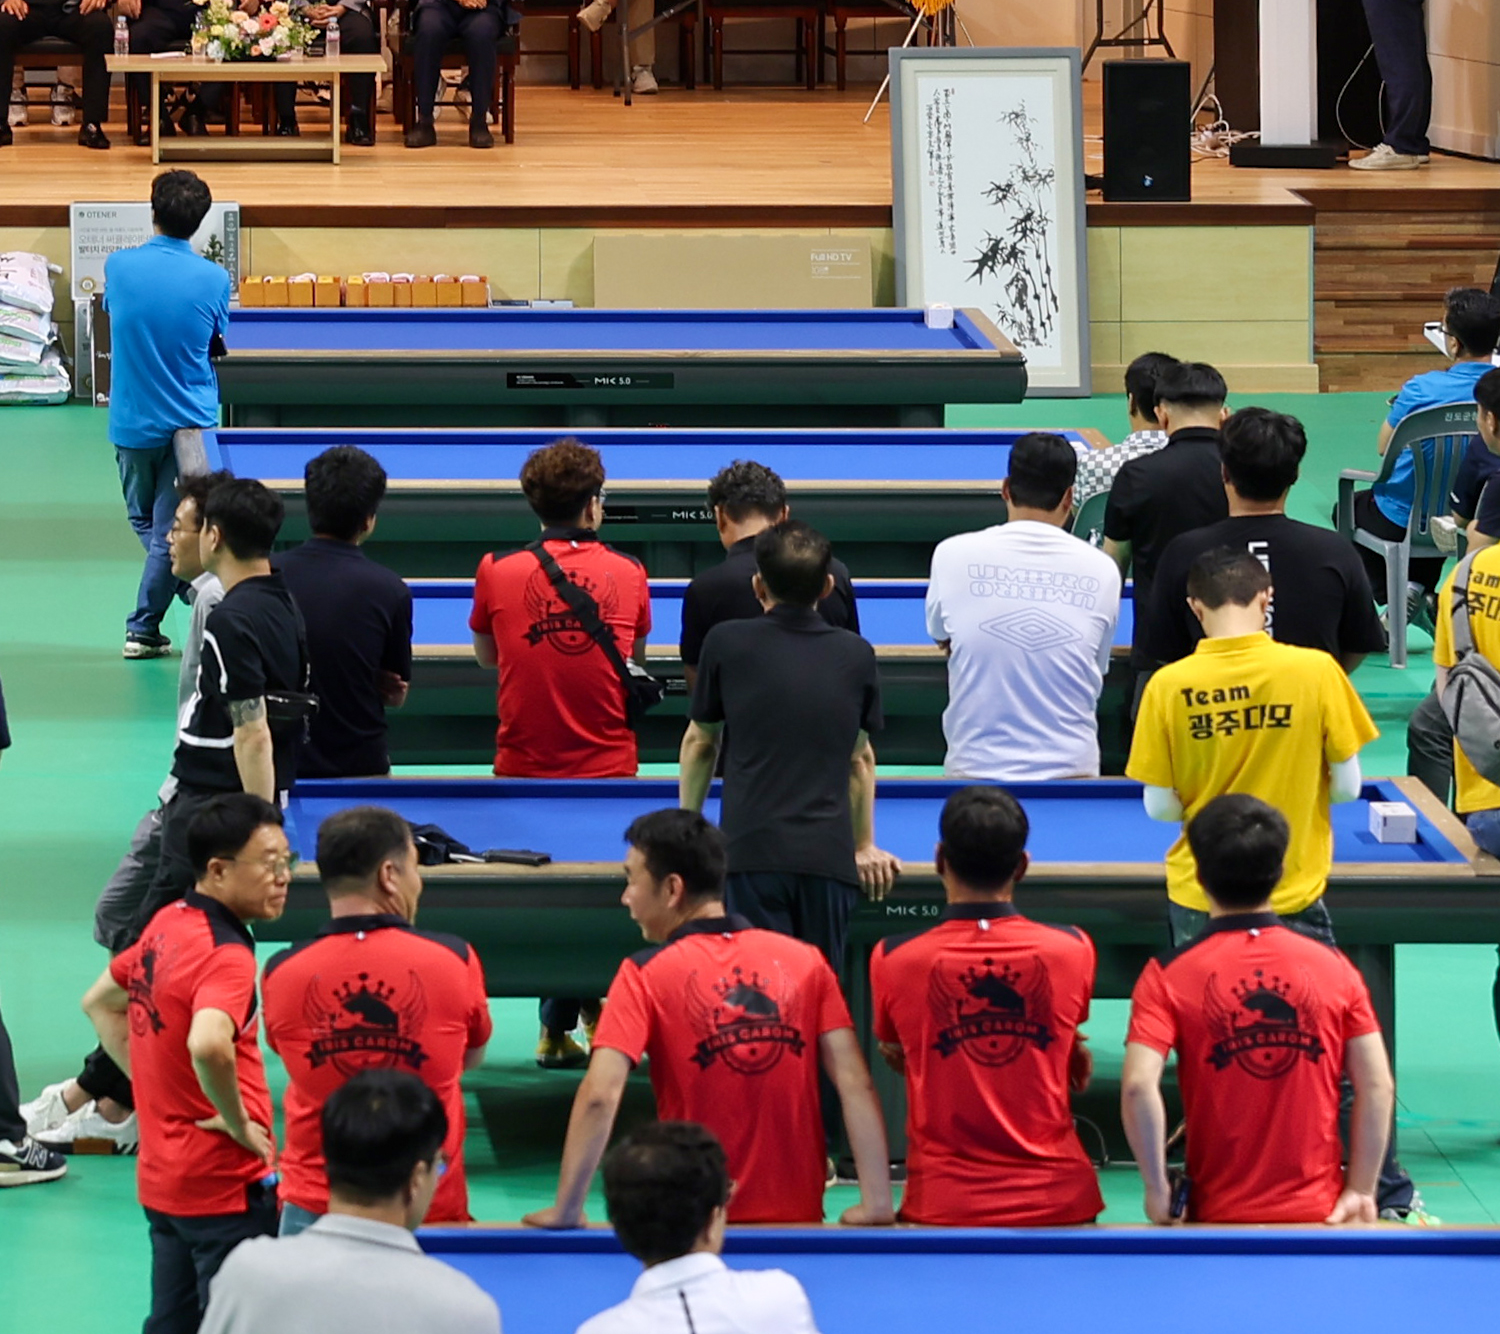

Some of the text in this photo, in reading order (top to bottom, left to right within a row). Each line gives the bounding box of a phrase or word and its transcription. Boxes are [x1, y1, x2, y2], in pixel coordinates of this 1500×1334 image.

[811, 253, 852, 261] Full HD TV
[618, 377, 631, 385] 5.0
[699, 511, 713, 520] 5.0
[967, 563, 1100, 595] UMBRO
[1181, 685, 1251, 707] Team
[1188, 703, 1294, 740] 광주다모
[921, 905, 939, 916] 5.0
